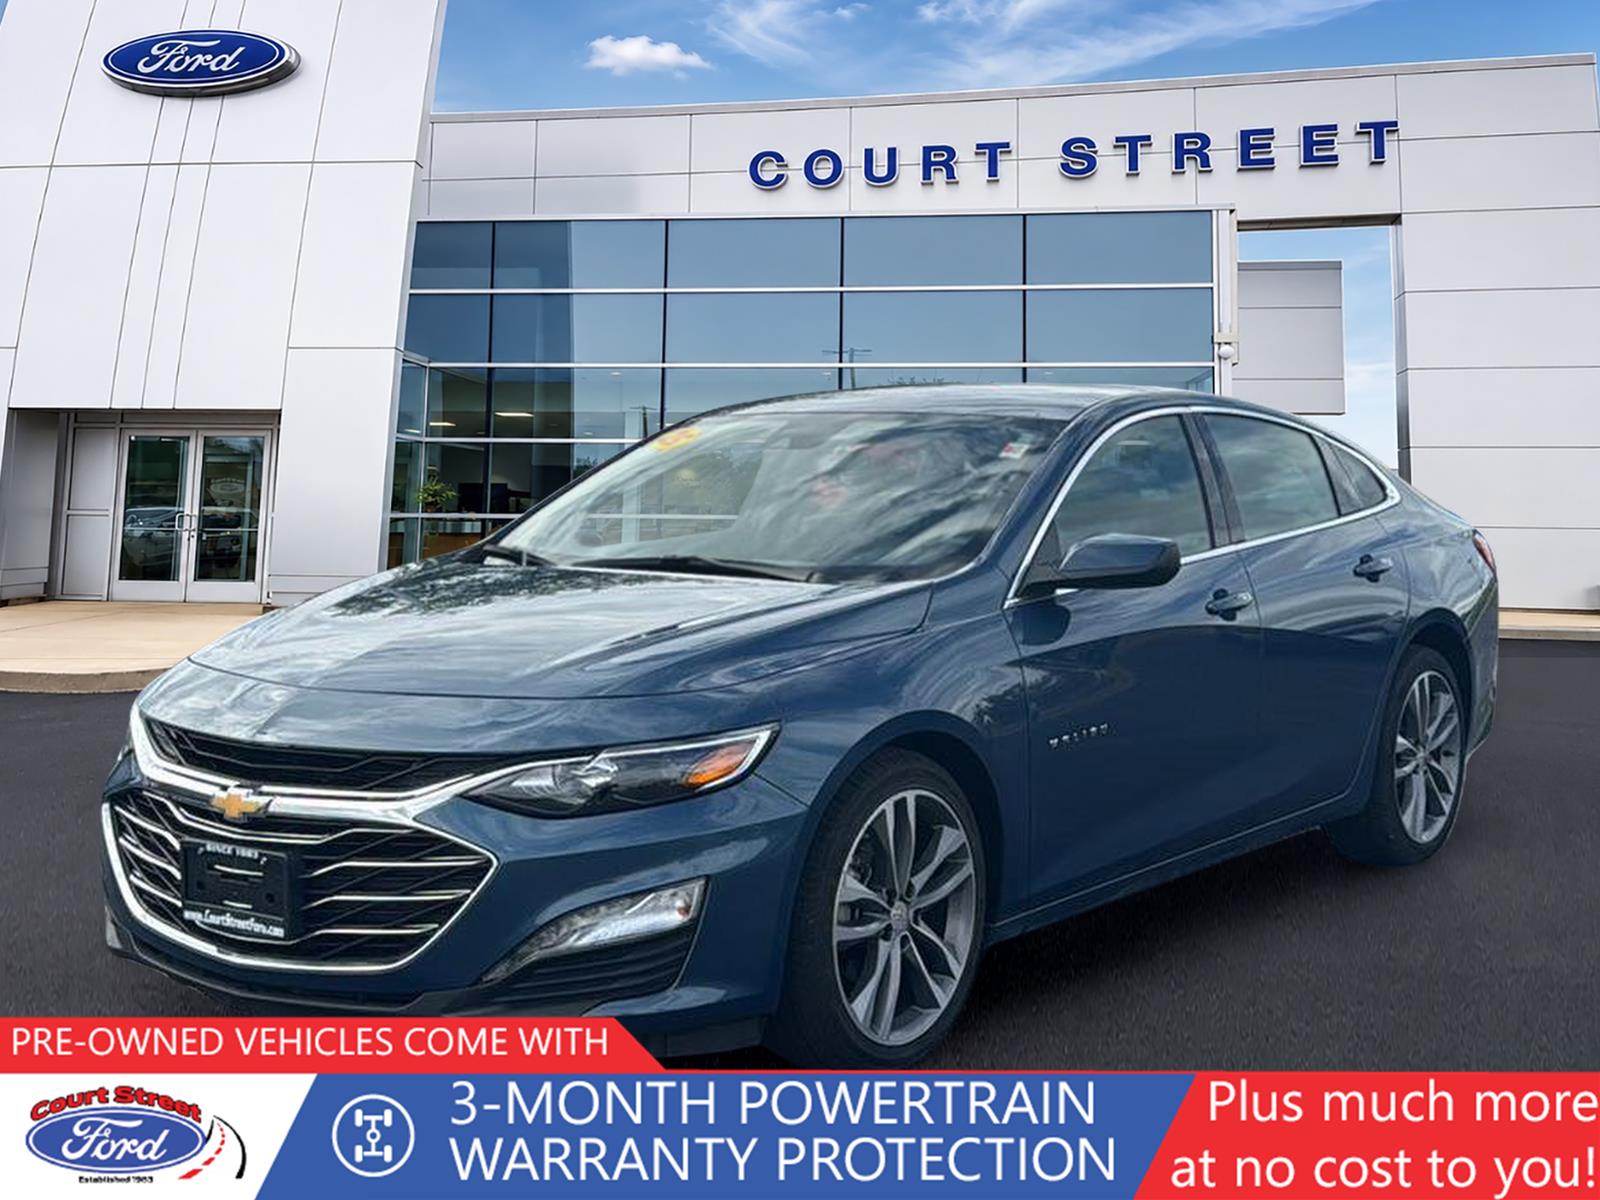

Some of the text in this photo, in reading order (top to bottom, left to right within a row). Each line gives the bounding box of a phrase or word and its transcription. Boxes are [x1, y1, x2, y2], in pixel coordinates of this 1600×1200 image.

[137, 40, 246, 73] Ford
[748, 120, 1400, 189] COURT STREET
